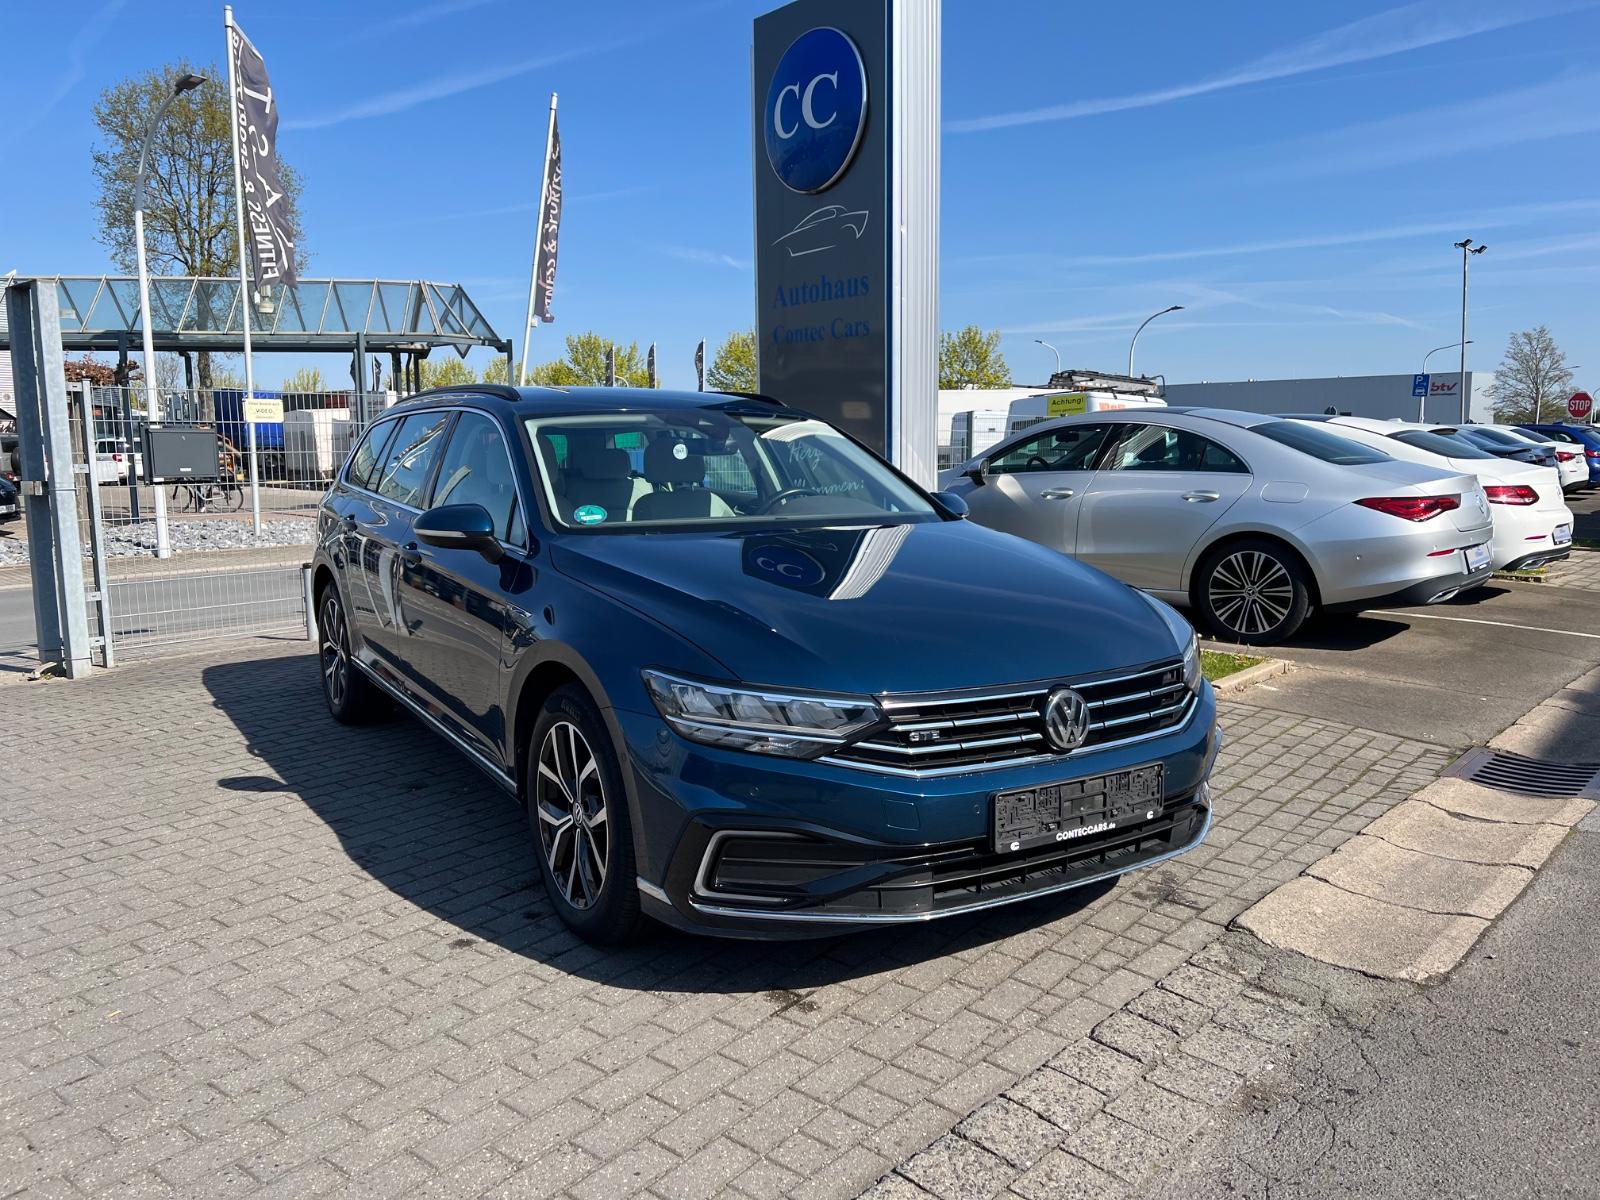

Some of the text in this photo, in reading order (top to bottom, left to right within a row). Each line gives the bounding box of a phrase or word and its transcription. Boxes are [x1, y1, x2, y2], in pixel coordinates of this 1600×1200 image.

[773, 70, 838, 140] CC
[772, 274, 870, 309] Autohaus
[772, 317, 871, 344] Contec Cars
[1415, 375, 1424, 385] P
[1430, 382, 1458, 392] btv
[1051, 397, 1084, 406] Achtung!
[1569, 400, 1591, 411] STOP
[909, 730, 940, 742] GTE
[1055, 821, 1117, 842] CONTECCARS.de
